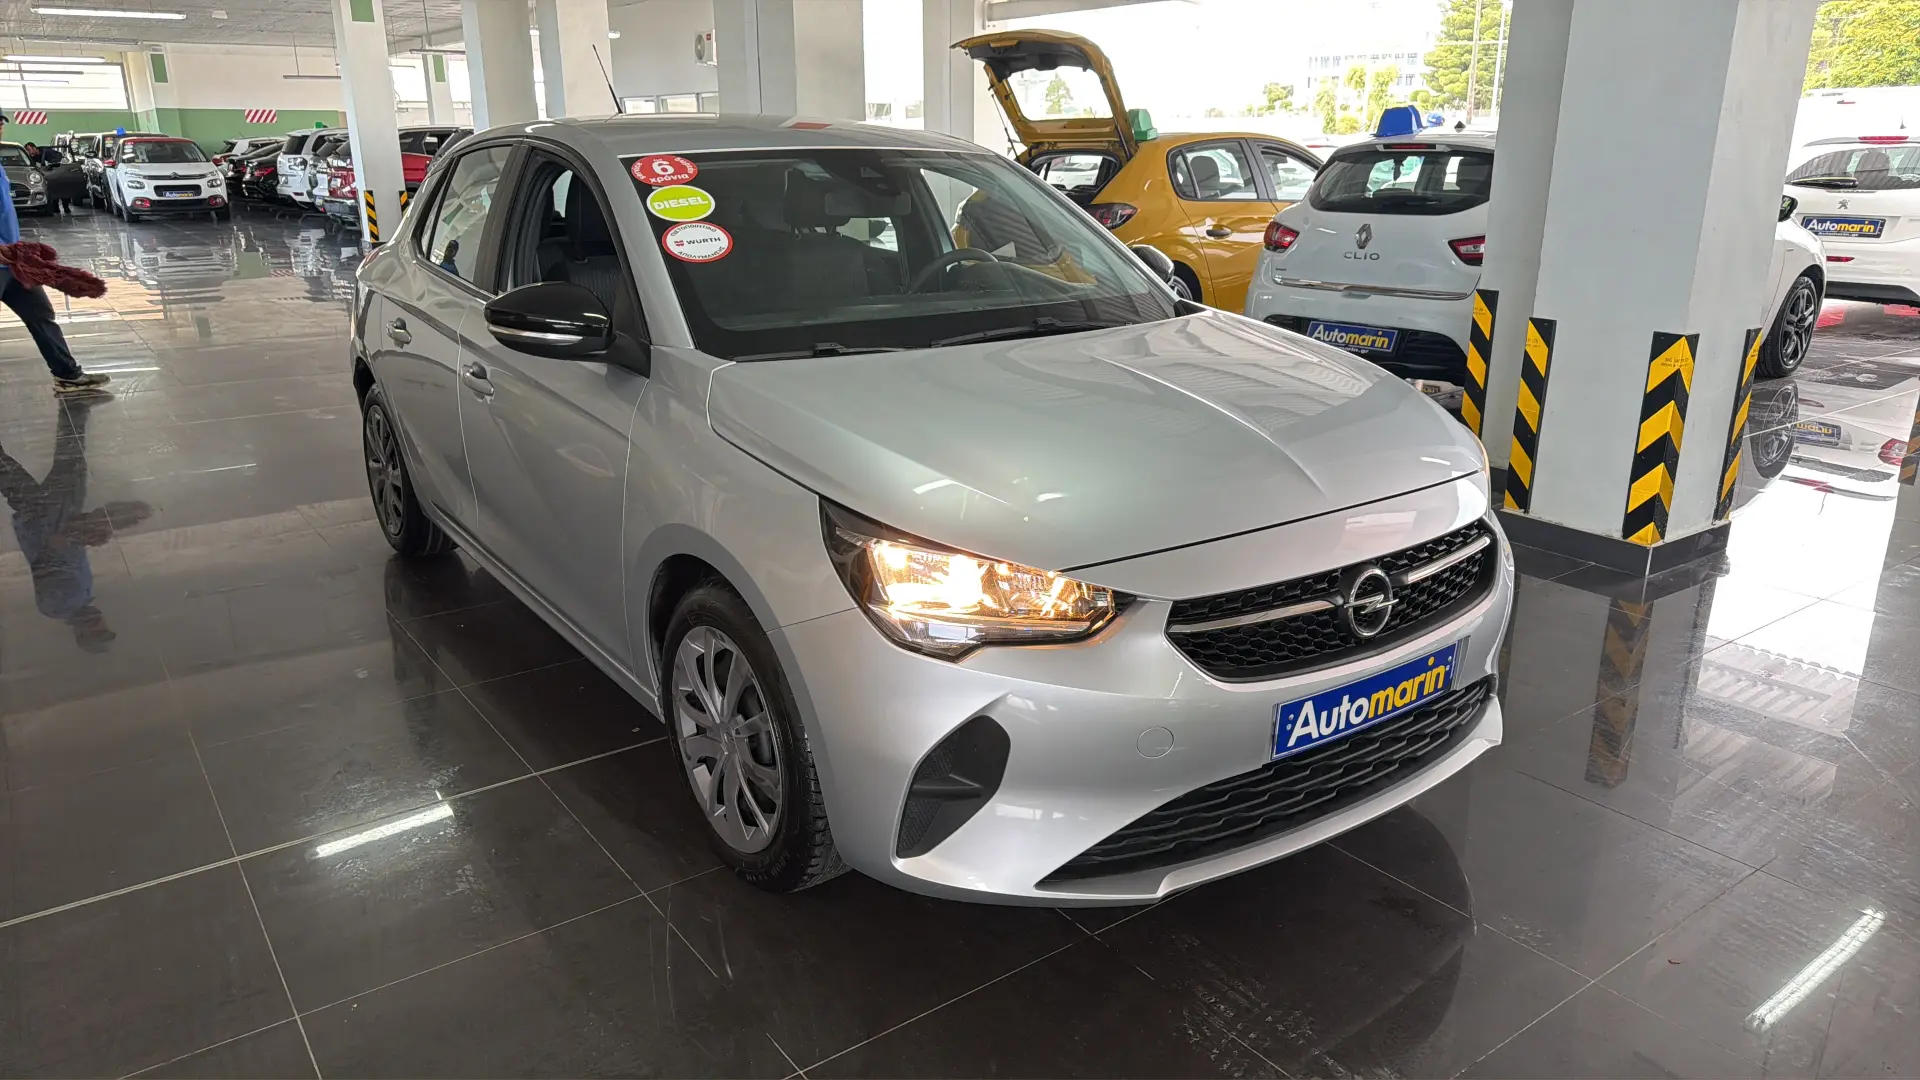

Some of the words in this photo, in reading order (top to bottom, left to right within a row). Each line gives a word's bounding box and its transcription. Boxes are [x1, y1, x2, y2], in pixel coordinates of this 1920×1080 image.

[652, 160, 675, 176] 6
[649, 171, 690, 184] χρόνια
[653, 196, 708, 210] DIESEL
[1807, 219, 1875, 233] Automarin
[1311, 324, 1389, 349] Automarin
[1287, 656, 1446, 747] Automarin
